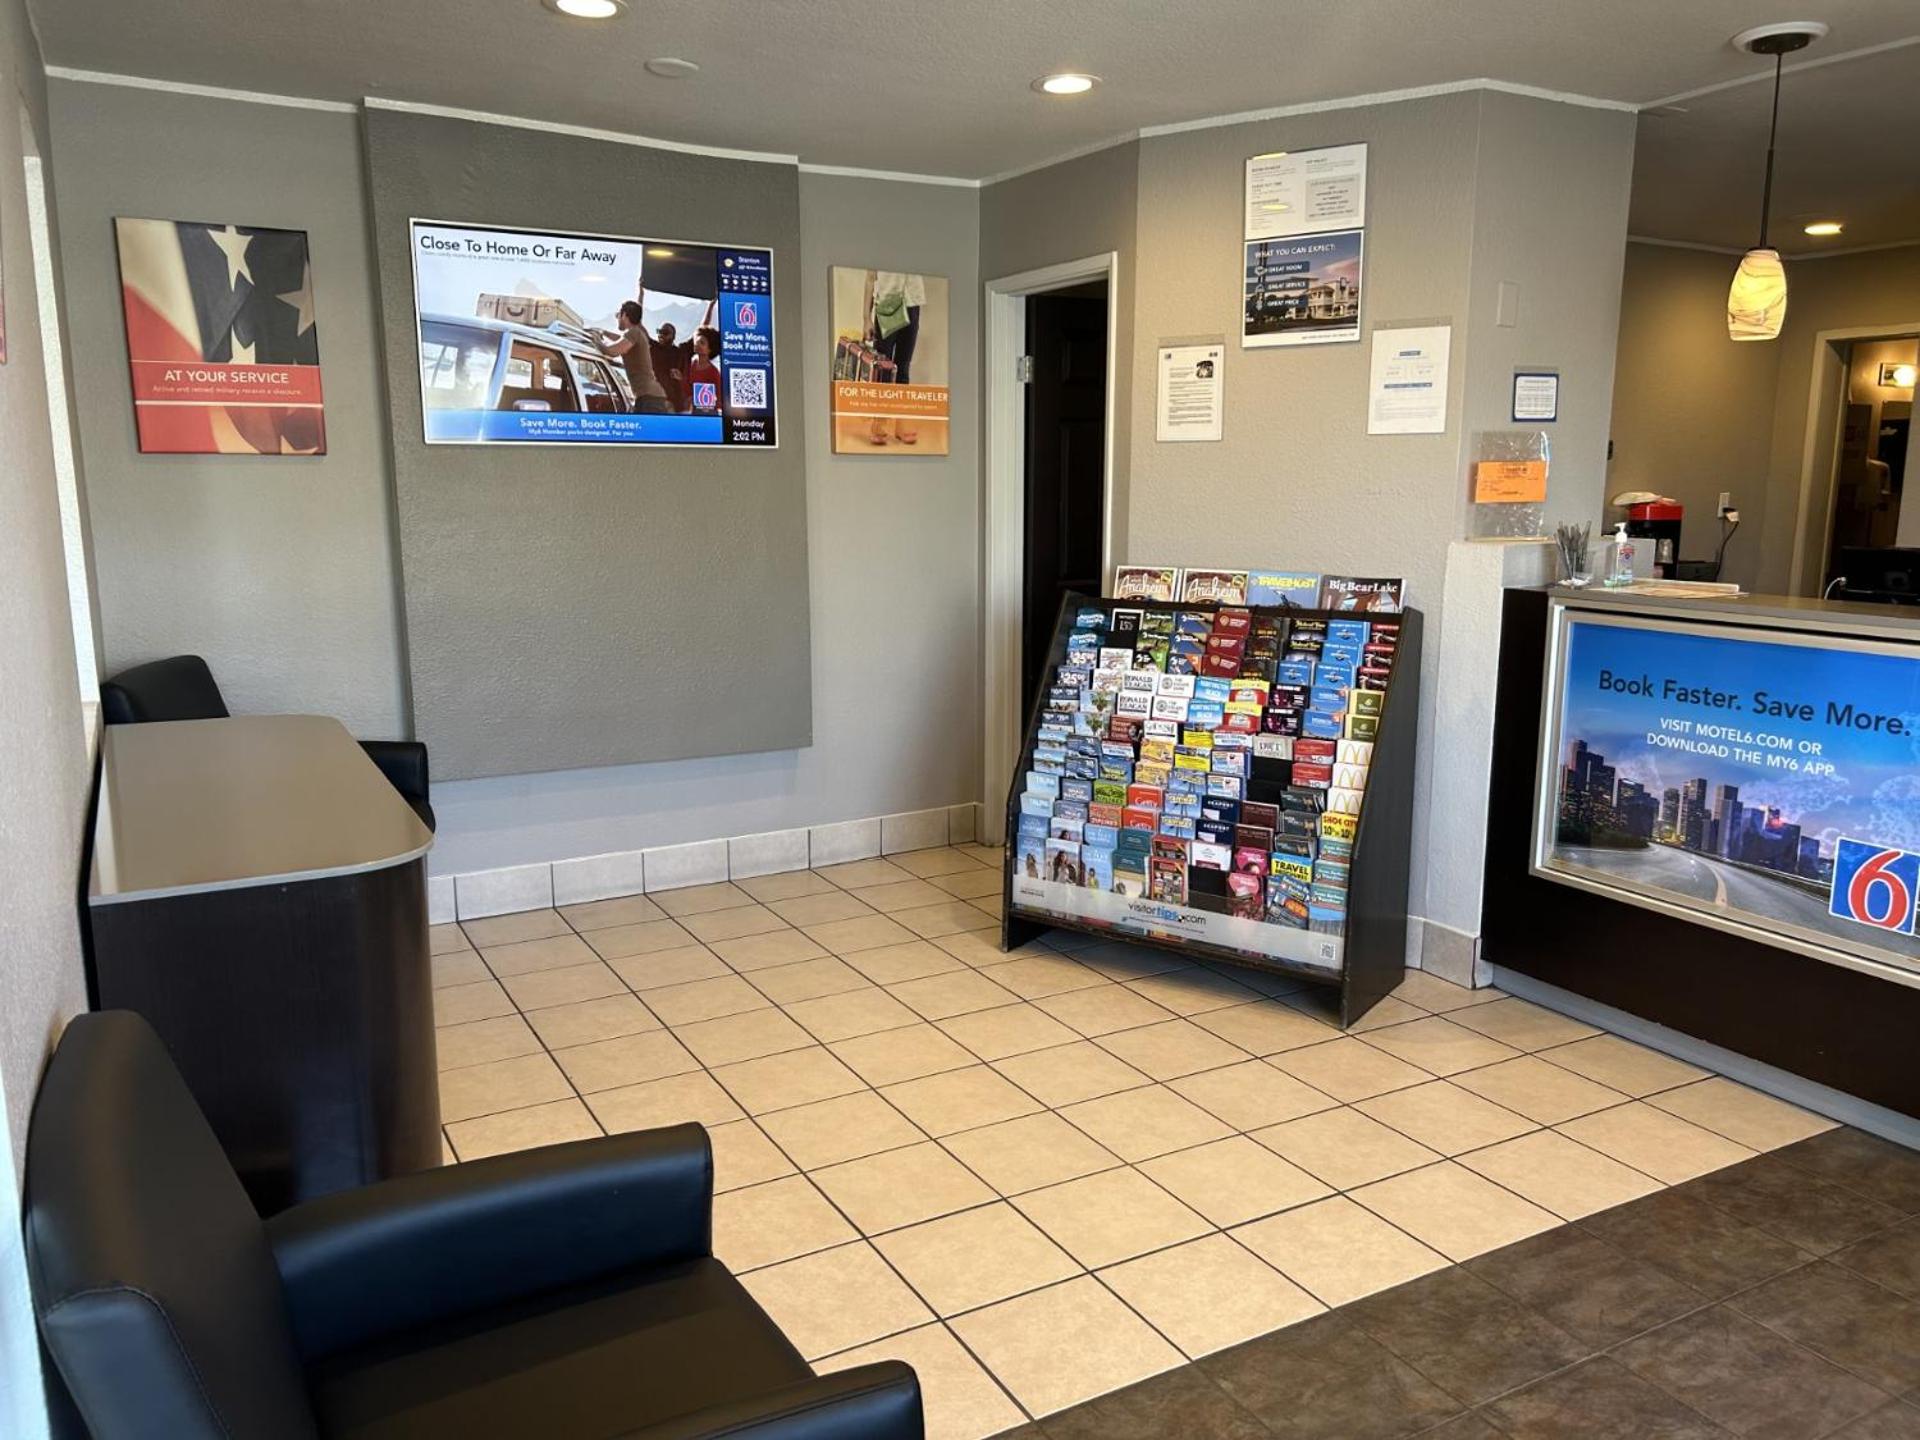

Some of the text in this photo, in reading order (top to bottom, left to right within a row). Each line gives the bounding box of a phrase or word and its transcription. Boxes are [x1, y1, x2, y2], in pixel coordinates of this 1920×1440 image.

[420, 235, 460, 251] Close
[464, 239, 482, 253] To
[487, 241, 528, 256] Home
[533, 244, 550, 258] Or
[555, 246, 577, 260] Far
[581, 249, 617, 266] Away
[1276, 248, 1290, 257] YOU
[1291, 246, 1307, 254] CAN
[724, 331, 768, 342] Save More.
[723, 342, 770, 351] Book Faster.
[164, 370, 289, 384] AT YOUR SERVICE
[839, 387, 948, 402] FOR THE LIGHT TRAVELER
[520, 417, 642, 430] Save More. Book Faster.
[733, 419, 765, 429] Monday
[733, 431, 765, 441] 2:02 PM
[1120, 573, 1168, 595] Anaheim
[1187, 576, 1240, 598] Anaheim
[1329, 579, 1398, 593] Big Bear Lake
[1598, 670, 1911, 737] Book Faster. Save More.
[1660, 717, 1822, 756] VISIT MOTEL6.COM OR
[1647, 732, 1835, 777] DOWNLOAD THE MY6 APP
[1275, 860, 1309, 875] TRAVEL
[1848, 849, 1910, 931] 6
[1128, 903, 1206, 925] visitortips.com
